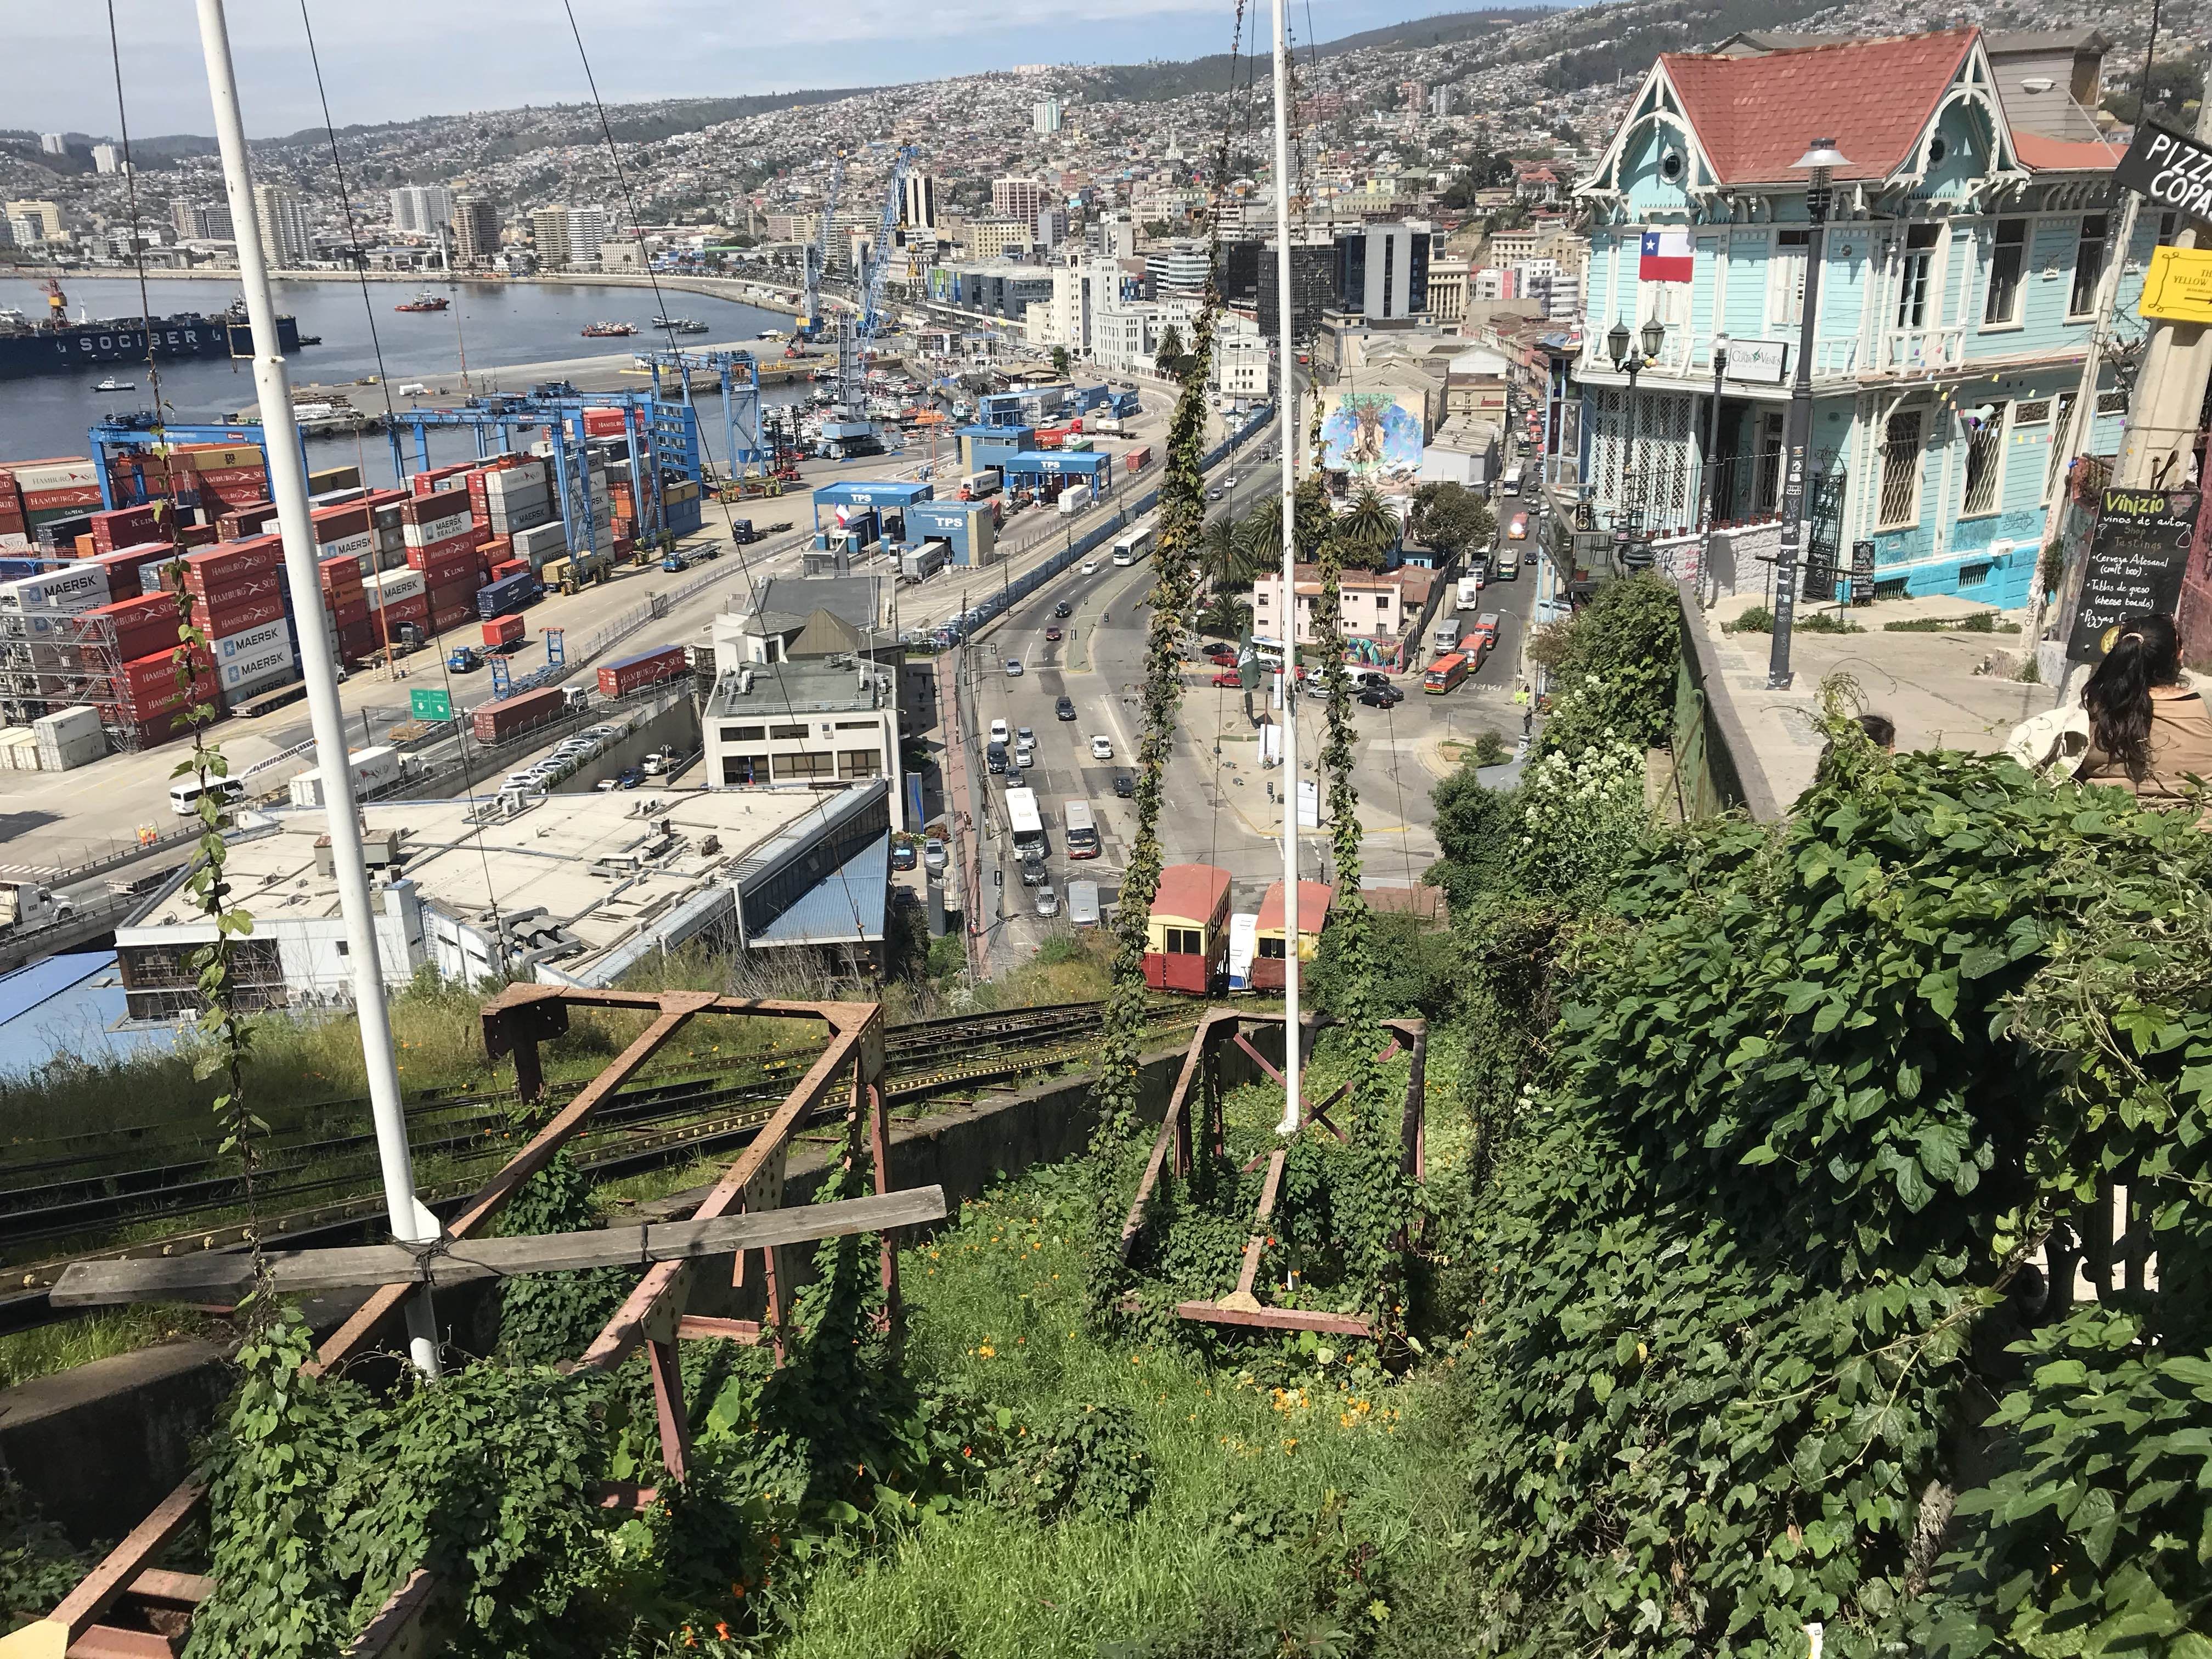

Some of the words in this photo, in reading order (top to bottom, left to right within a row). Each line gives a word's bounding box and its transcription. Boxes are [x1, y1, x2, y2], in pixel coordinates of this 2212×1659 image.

[2150, 170, 2212, 223] COPA
[2174, 275, 2209, 286] YELLOW
[79, 330, 198, 351] SOCIBER
[33, 475, 71, 485] HAMBURG
[199, 475, 235, 483] HAMBURG
[31, 495, 74, 505] HAMBURG
[918, 489, 927, 499] TPS
[436, 516, 462, 531] MAERSK
[518, 509, 545, 523] MAERSK
[934, 517, 963, 527] TPS
[2103, 516, 2131, 524] vinos
[2137, 516, 2151, 526] de
[2157, 516, 2187, 527] autor
[2124, 526, 2146, 539] Shop
[338, 537, 373, 555] MAERSK
[2114, 536, 2163, 553] Tastings
[2096, 552, 2129, 566] Cerveza
[212, 561, 244, 576] HAMBURG
[44, 574, 97, 597] MAERSK
[384, 579, 418, 599] MAERSK
[2091, 579, 2114, 591] Tablas
[2117, 581, 2127, 591] de
[2129, 586, 2150, 597] queso
[211, 587, 246, 604] HAMBURG
[2095, 595, 2122, 606] (cheese
[2125, 597, 2154, 610] boards)
[221, 612, 252, 629] HAMBURG
[436, 610, 461, 626] HAMBURG
[2084, 608, 2114, 629] Pizzas
[235, 628, 279, 650] MAERSK
[241, 652, 285, 676] MAERSK
[142, 665, 178, 683] HAMBURG
[620, 666, 654, 685] HAMBURG
[1468, 682, 1503, 692] PARE
